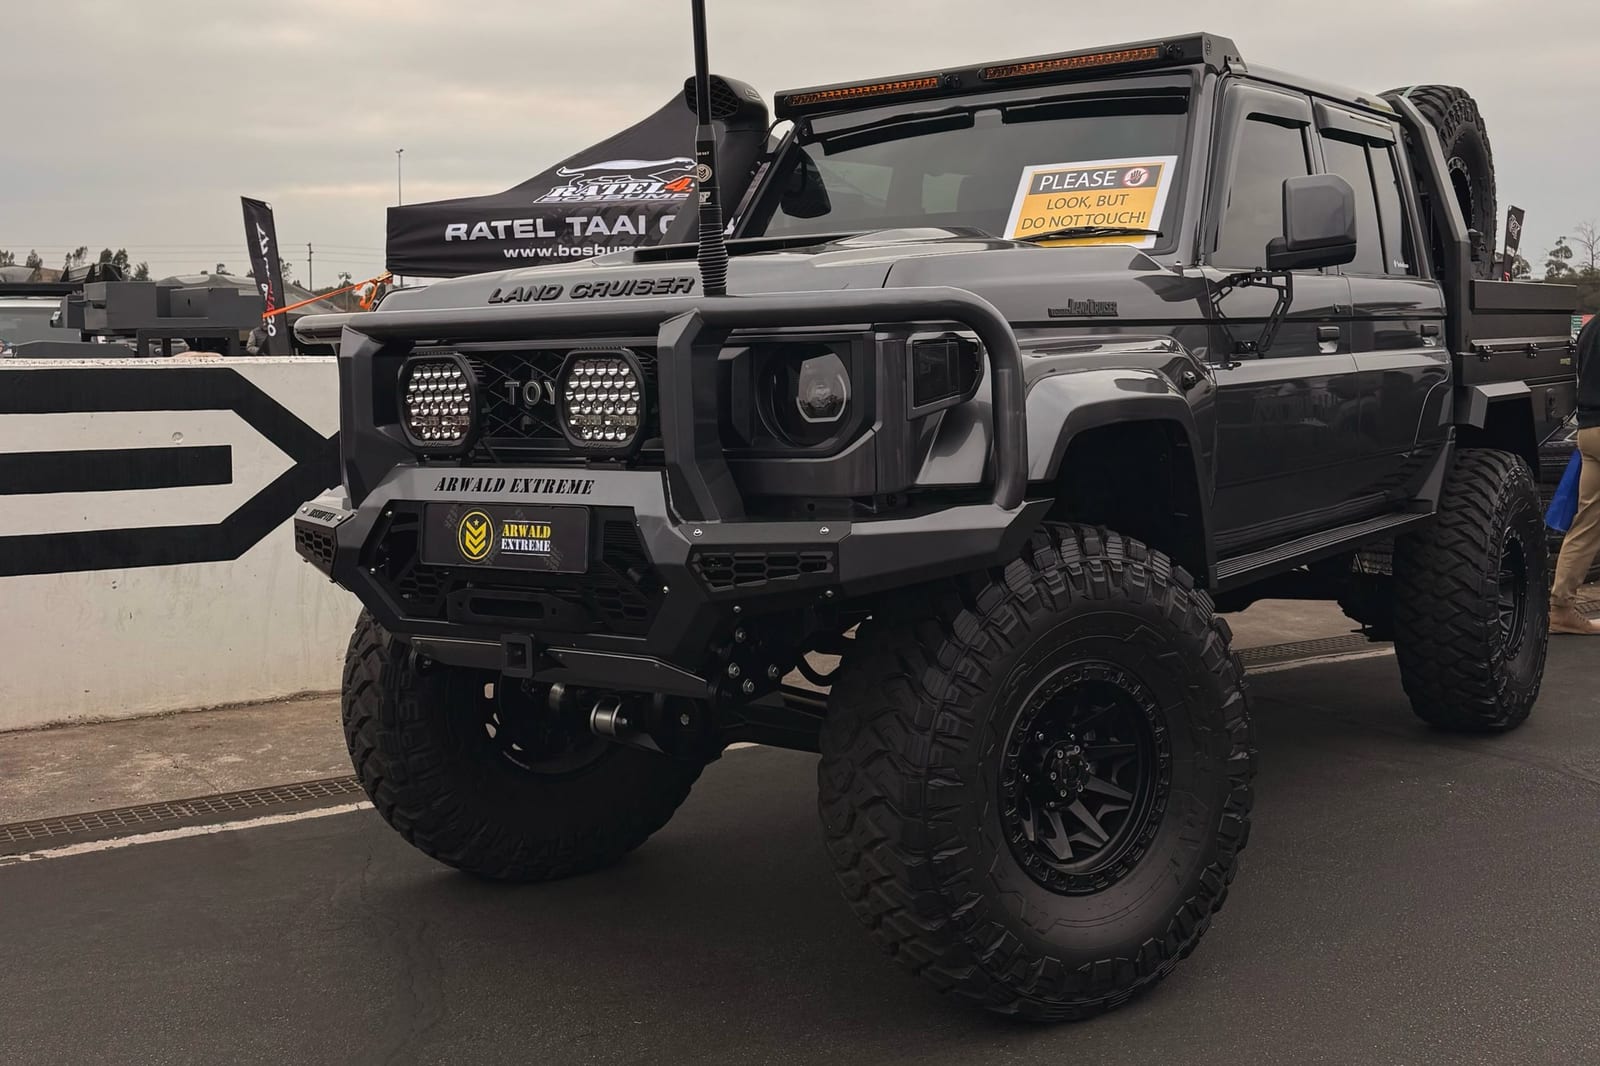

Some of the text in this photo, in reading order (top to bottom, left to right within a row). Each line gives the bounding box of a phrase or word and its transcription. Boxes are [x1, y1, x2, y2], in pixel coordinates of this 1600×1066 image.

[1039, 170, 1117, 191] PLEASE
[1046, 193, 1129, 210] LOOK, BUT
[445, 218, 556, 241] RATEL
[565, 215, 646, 237] TAAI
[1021, 211, 1146, 230] DO NOT TOUCH!
[503, 243, 647, 258] www.bosbum
[488, 276, 695, 304] LAND CRUISER
[504, 381, 556, 405] TOY
[434, 476, 595, 495] ARWALD EXTREME
[502, 524, 551, 539] ARWALD
[501, 538, 551, 552] EXTREME
